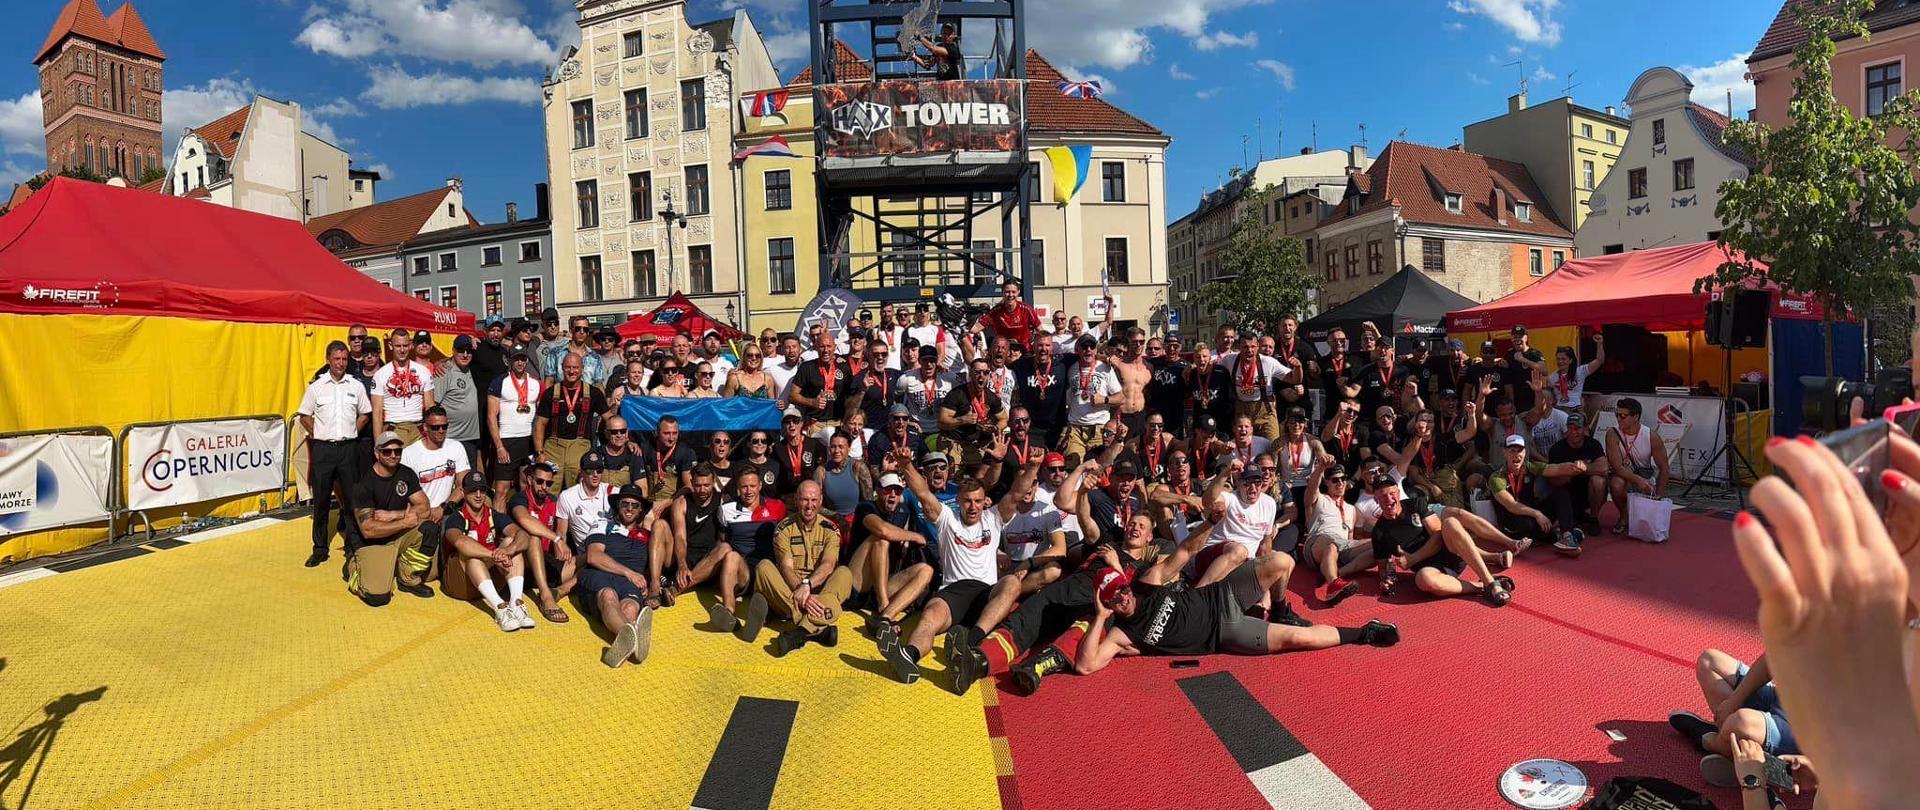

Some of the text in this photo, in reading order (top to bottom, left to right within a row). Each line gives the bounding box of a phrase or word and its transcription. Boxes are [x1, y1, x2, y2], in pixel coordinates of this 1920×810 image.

[901, 102, 1010, 128] TOWER
[39, 288, 100, 301] FIREFIT
[433, 311, 457, 325] RUKU
[186, 433, 249, 451] GALERIA
[142, 448, 273, 492] COPERNICUS
